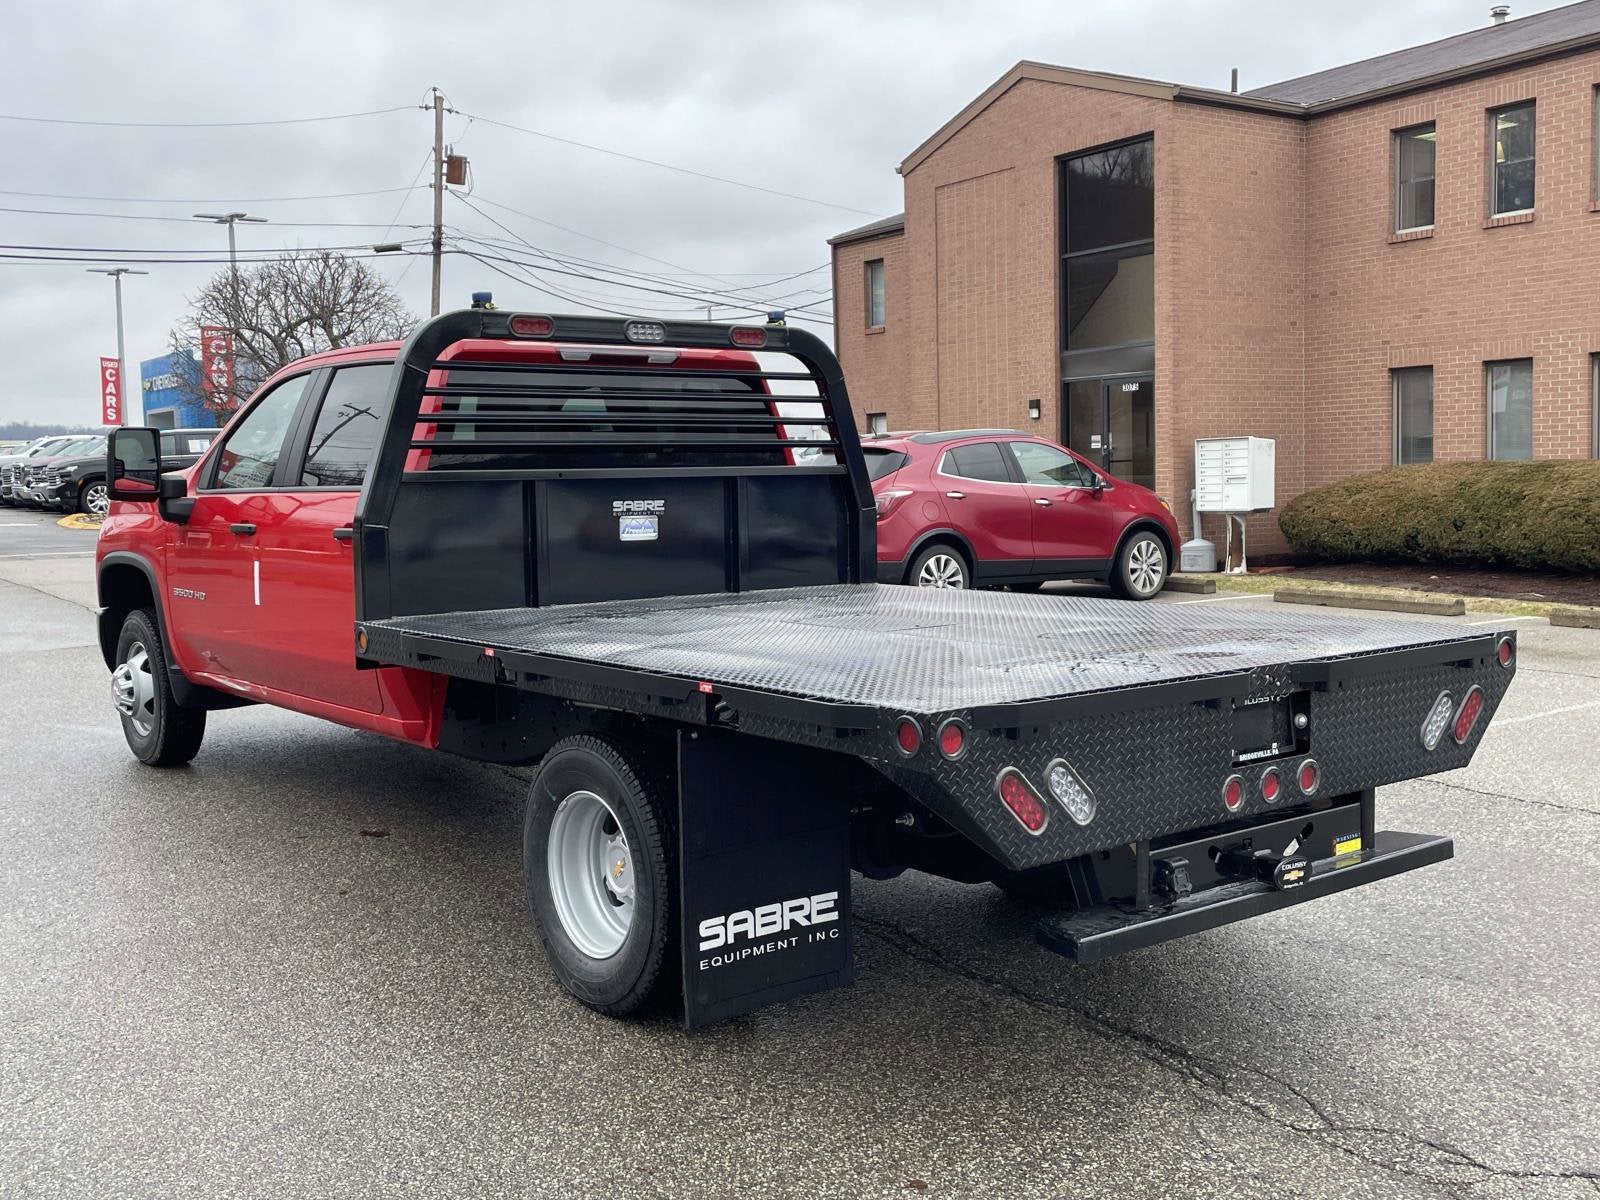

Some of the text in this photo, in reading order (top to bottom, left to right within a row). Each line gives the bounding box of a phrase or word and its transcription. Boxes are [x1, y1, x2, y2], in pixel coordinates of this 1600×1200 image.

[105, 369, 117, 421] CARS
[612, 500, 665, 512] SABRE
[173, 587, 206, 600] 3500 HD
[699, 891, 839, 952] SABRE
[700, 928, 840, 970] EQUIPMENT INC
